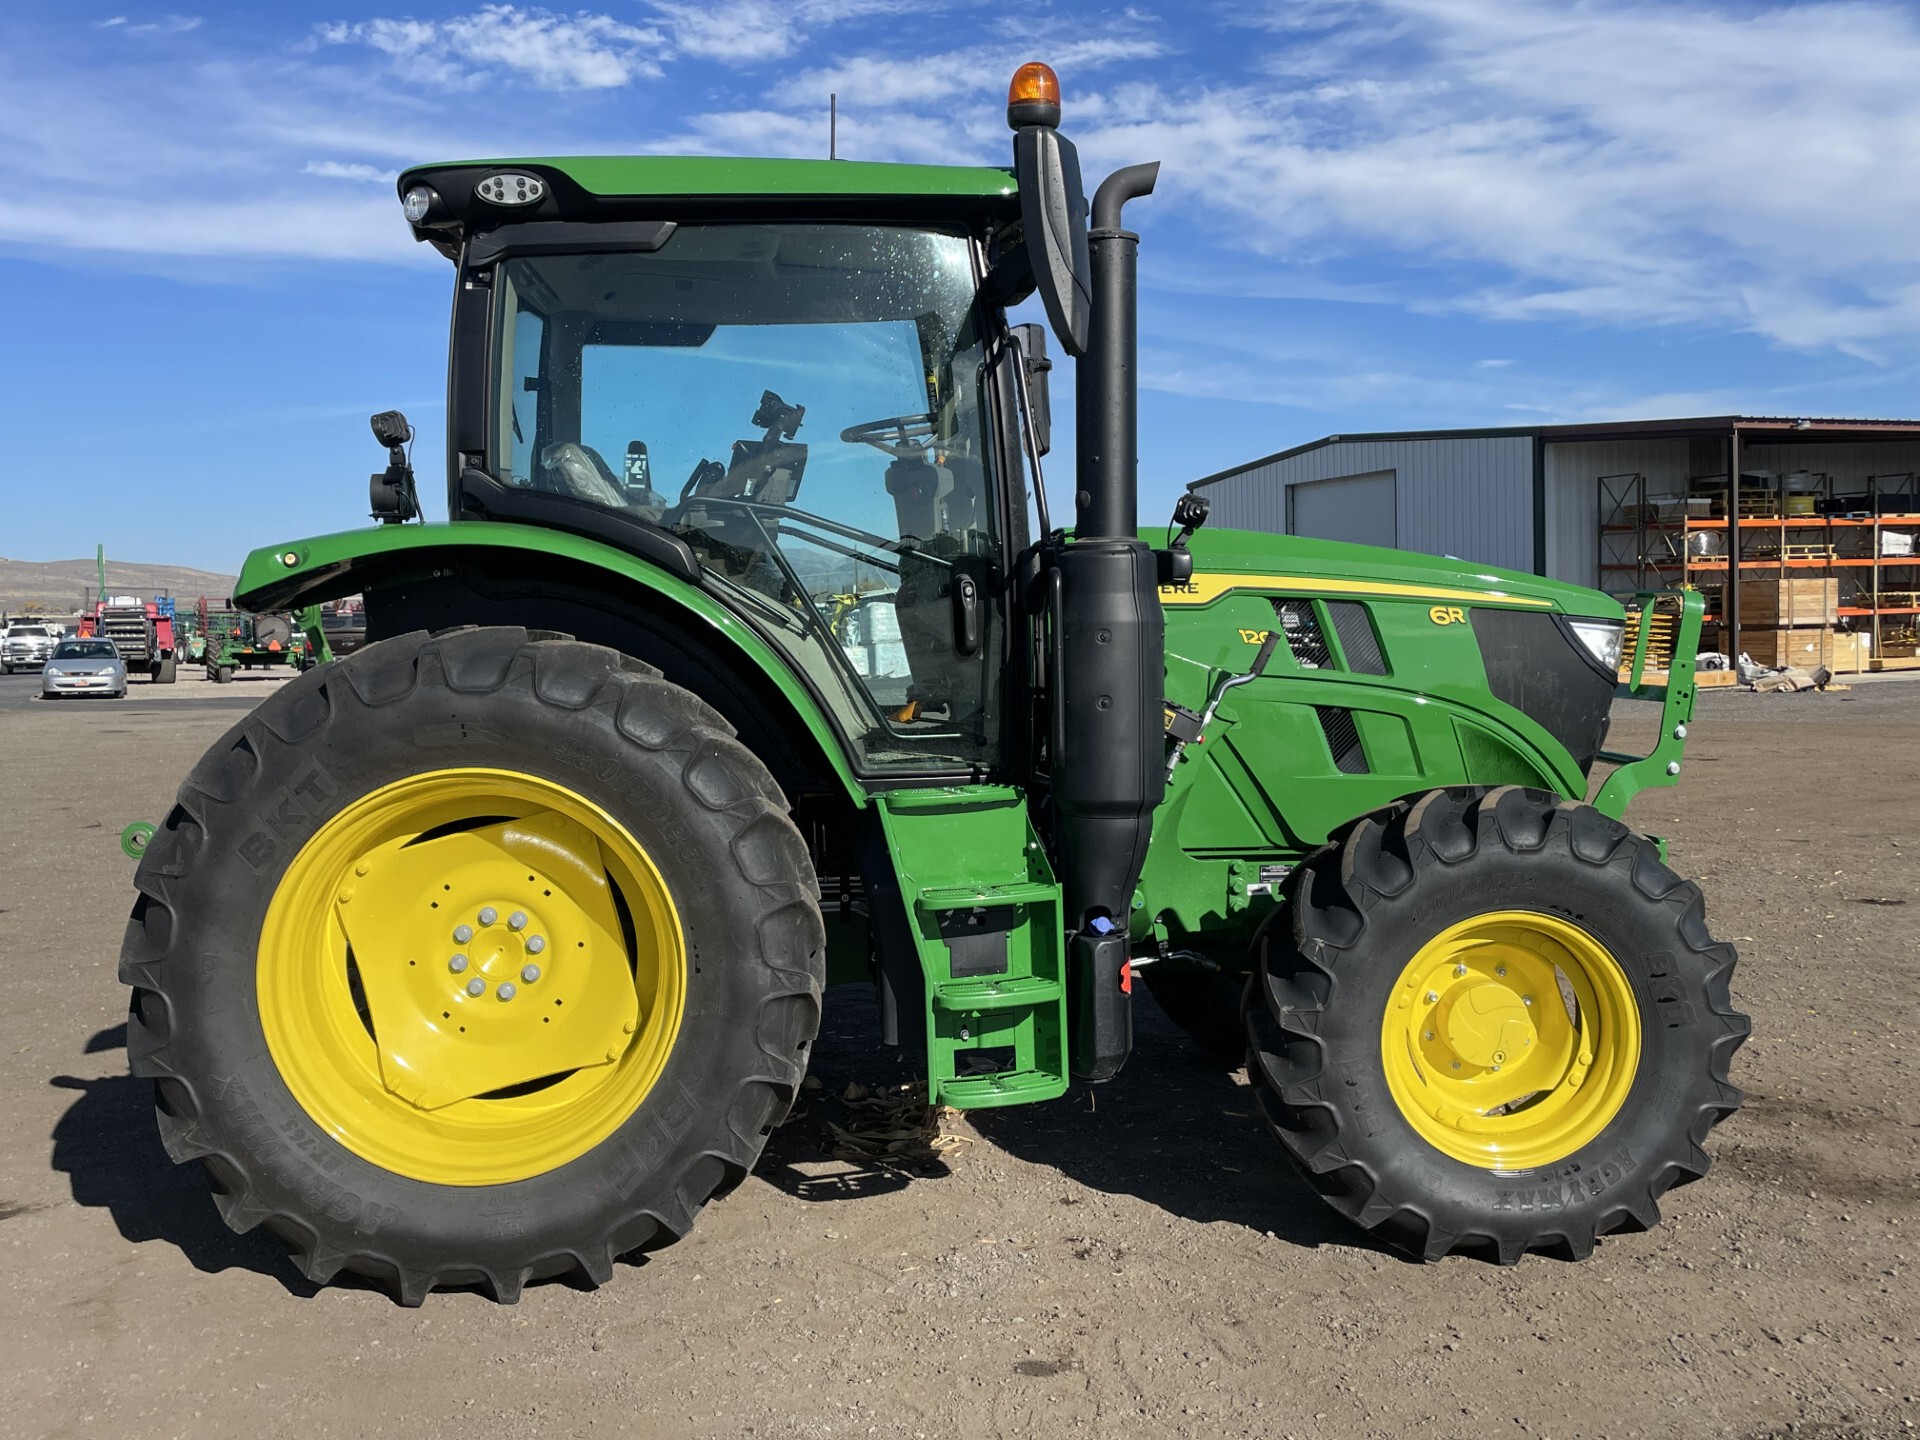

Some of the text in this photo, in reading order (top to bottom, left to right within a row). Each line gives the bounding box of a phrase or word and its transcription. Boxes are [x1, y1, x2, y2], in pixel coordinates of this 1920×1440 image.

[1161, 582, 1199, 594] ERE
[1428, 605, 1467, 626] 6R
[235, 762, 332, 872] BKT
